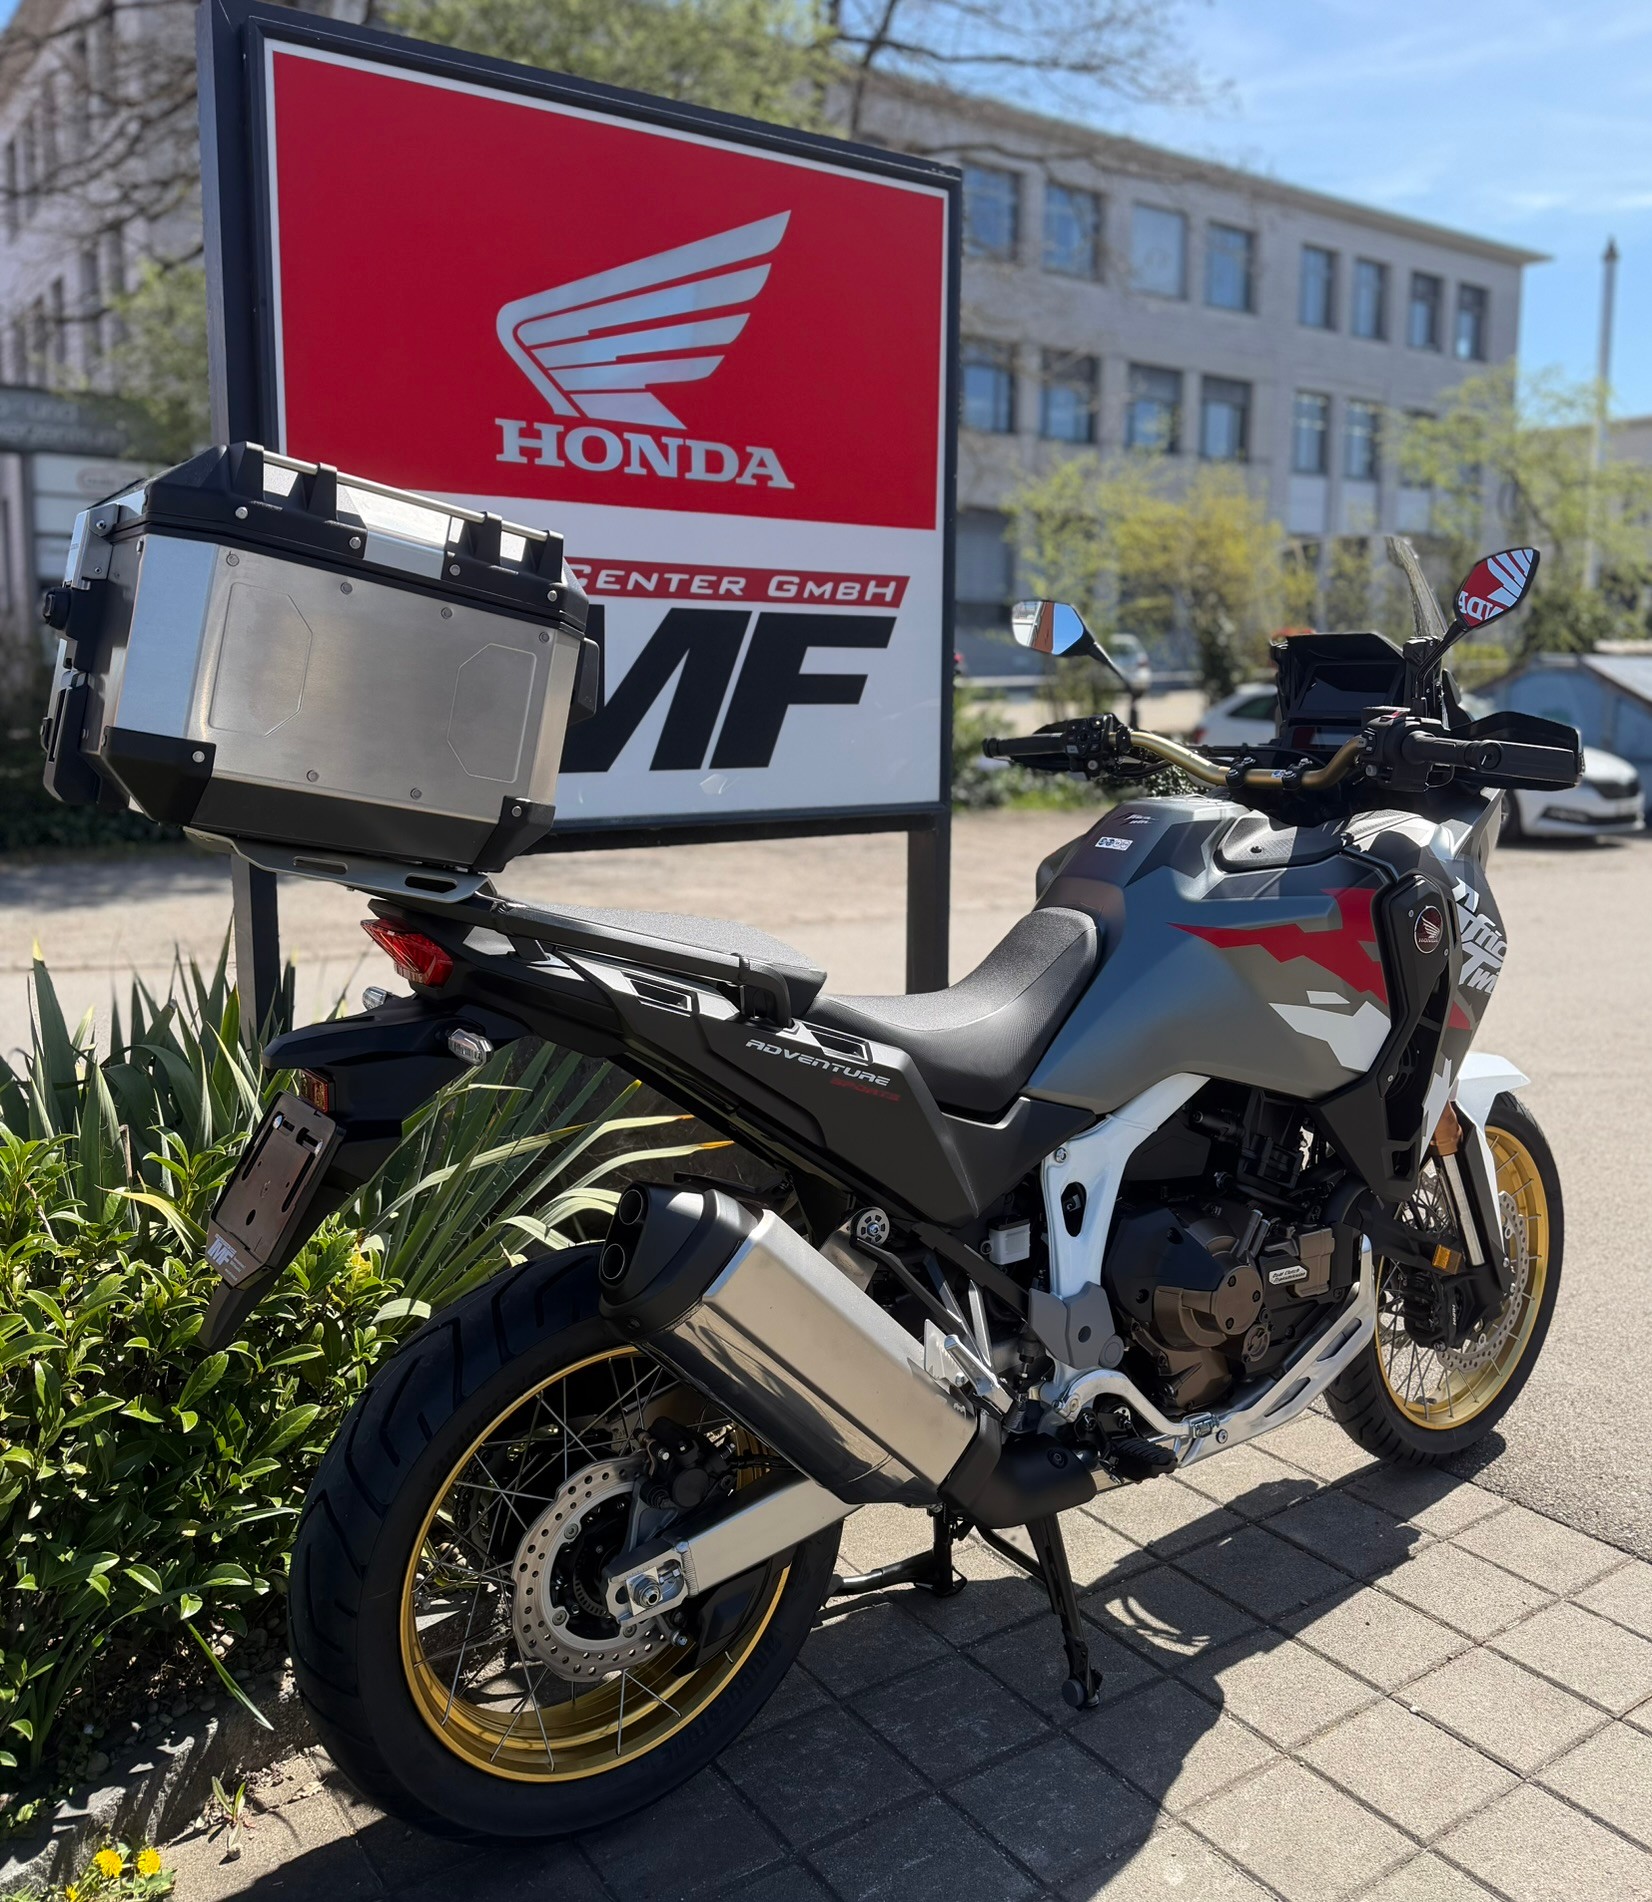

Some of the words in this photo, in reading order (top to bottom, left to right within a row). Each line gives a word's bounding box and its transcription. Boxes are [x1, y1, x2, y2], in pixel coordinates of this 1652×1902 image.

[494, 417, 795, 489] HONDA
[569, 563, 746, 596] CENTER
[1452, 876, 1508, 962] Afric
[1458, 941, 1503, 994] Twi
[745, 1039, 891, 1087] ADVENTURE
